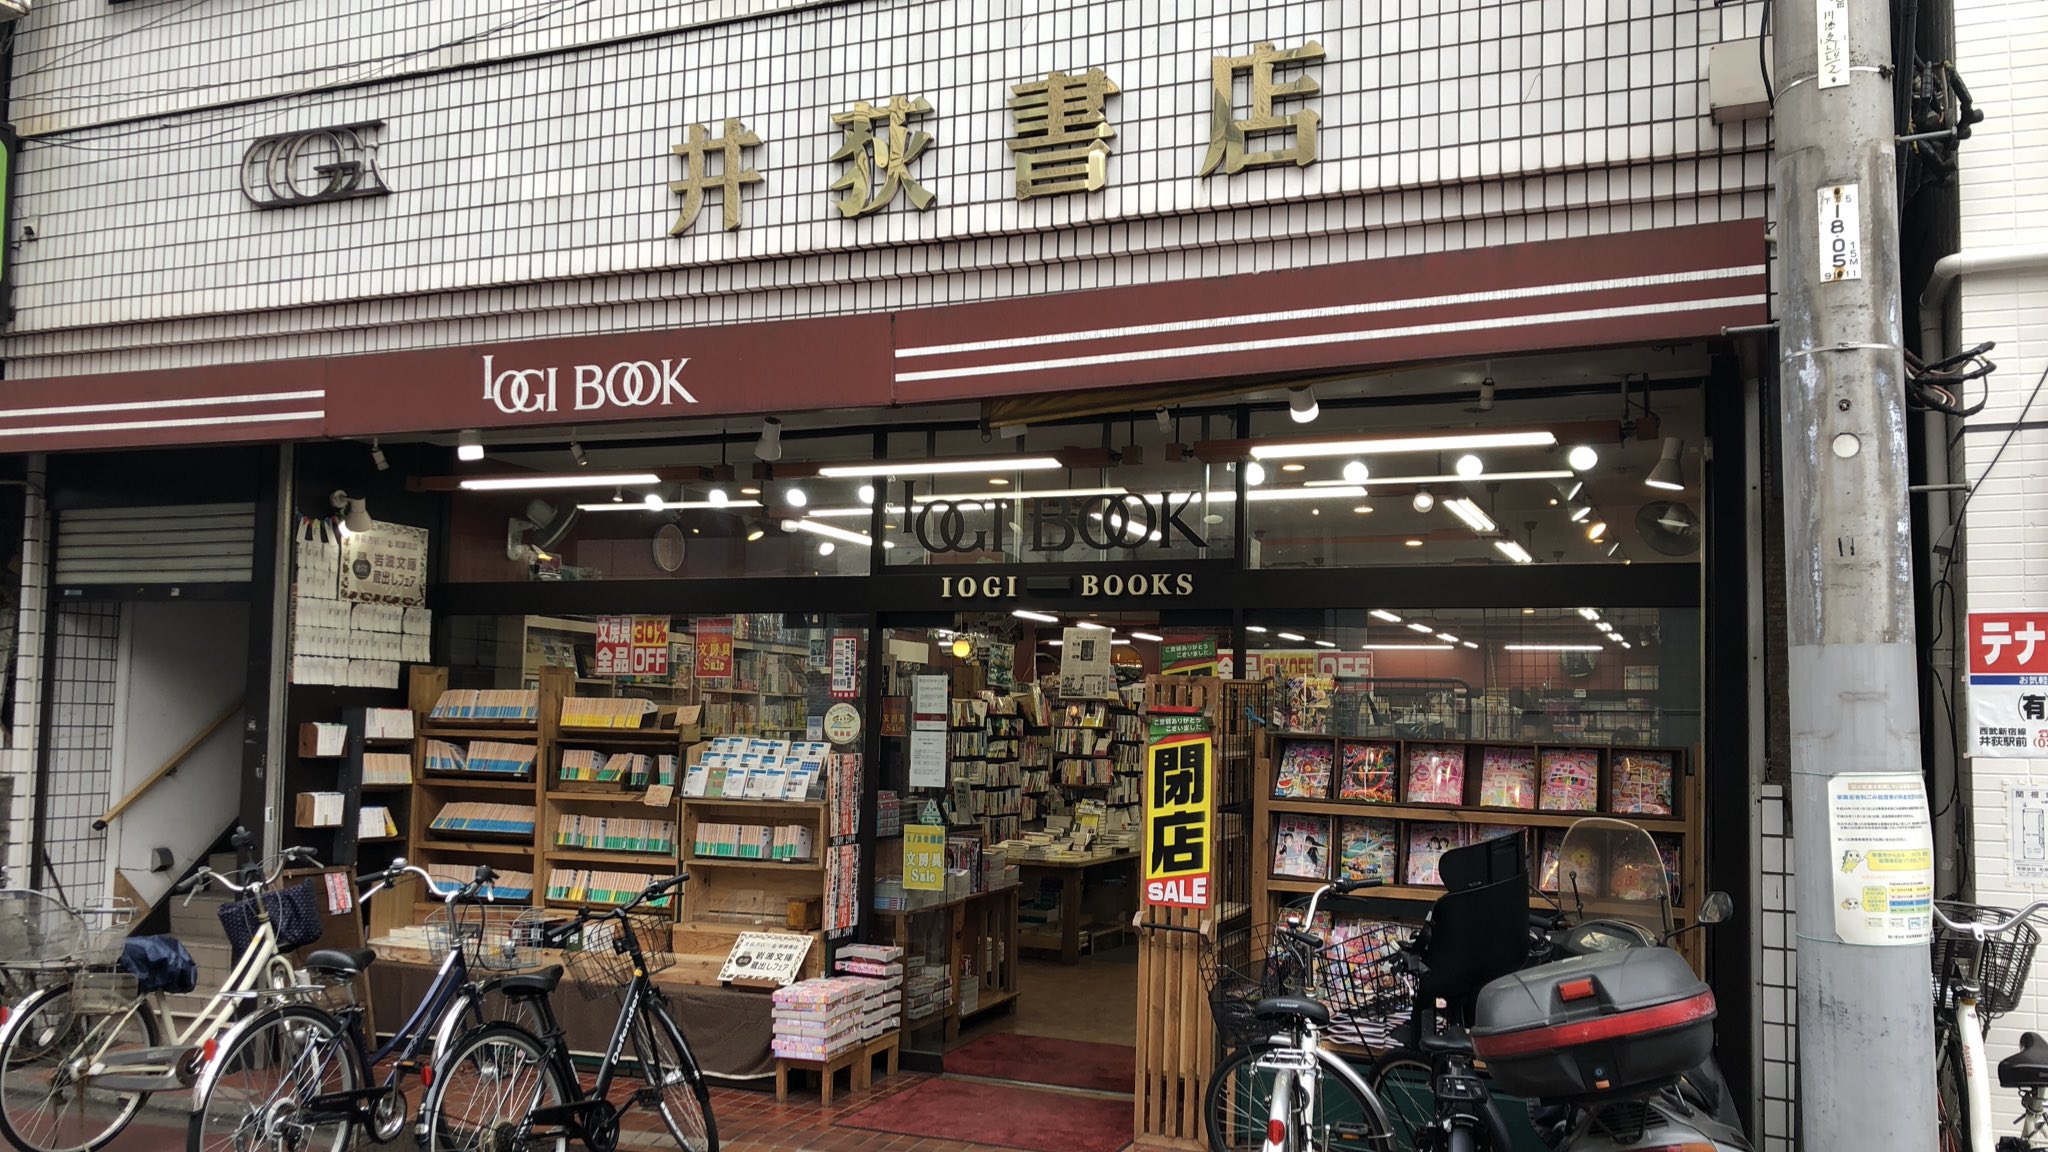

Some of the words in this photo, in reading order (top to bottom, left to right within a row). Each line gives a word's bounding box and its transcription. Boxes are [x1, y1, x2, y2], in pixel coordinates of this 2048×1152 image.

[668, 40, 1326, 237] 井荻書店
[482, 354, 559, 414] IOGI
[573, 357, 699, 407] BOOK
[903, 480, 1004, 553] IOGI
[1029, 490, 1210, 551] BOOK
[374, 552, 417, 572] 岩波文庫
[941, 575, 1018, 598] IOGI
[1081, 573, 1194, 597] BOOKS
[598, 617, 631, 644] 文房具
[634, 620, 667, 644] 30%
[698, 642, 731, 657] 文房具
[1982, 621, 2047, 666] テナ
[597, 646, 630, 673] 全品
[634, 647, 667, 672] OFF
[703, 658, 725, 671] Sale
[1979, 736, 2027, 747] 井荻駅前
[1980, 727, 2026, 736] 西武新宿線
[1152, 742, 1206, 875] 閉店
[905, 850, 943, 868] 文房具
[911, 868, 936, 883] Sale
[1147, 876, 1207, 905] SALE
[755, 951, 794, 962] 岩波文庫
[611, 990, 639, 1066] Defender
